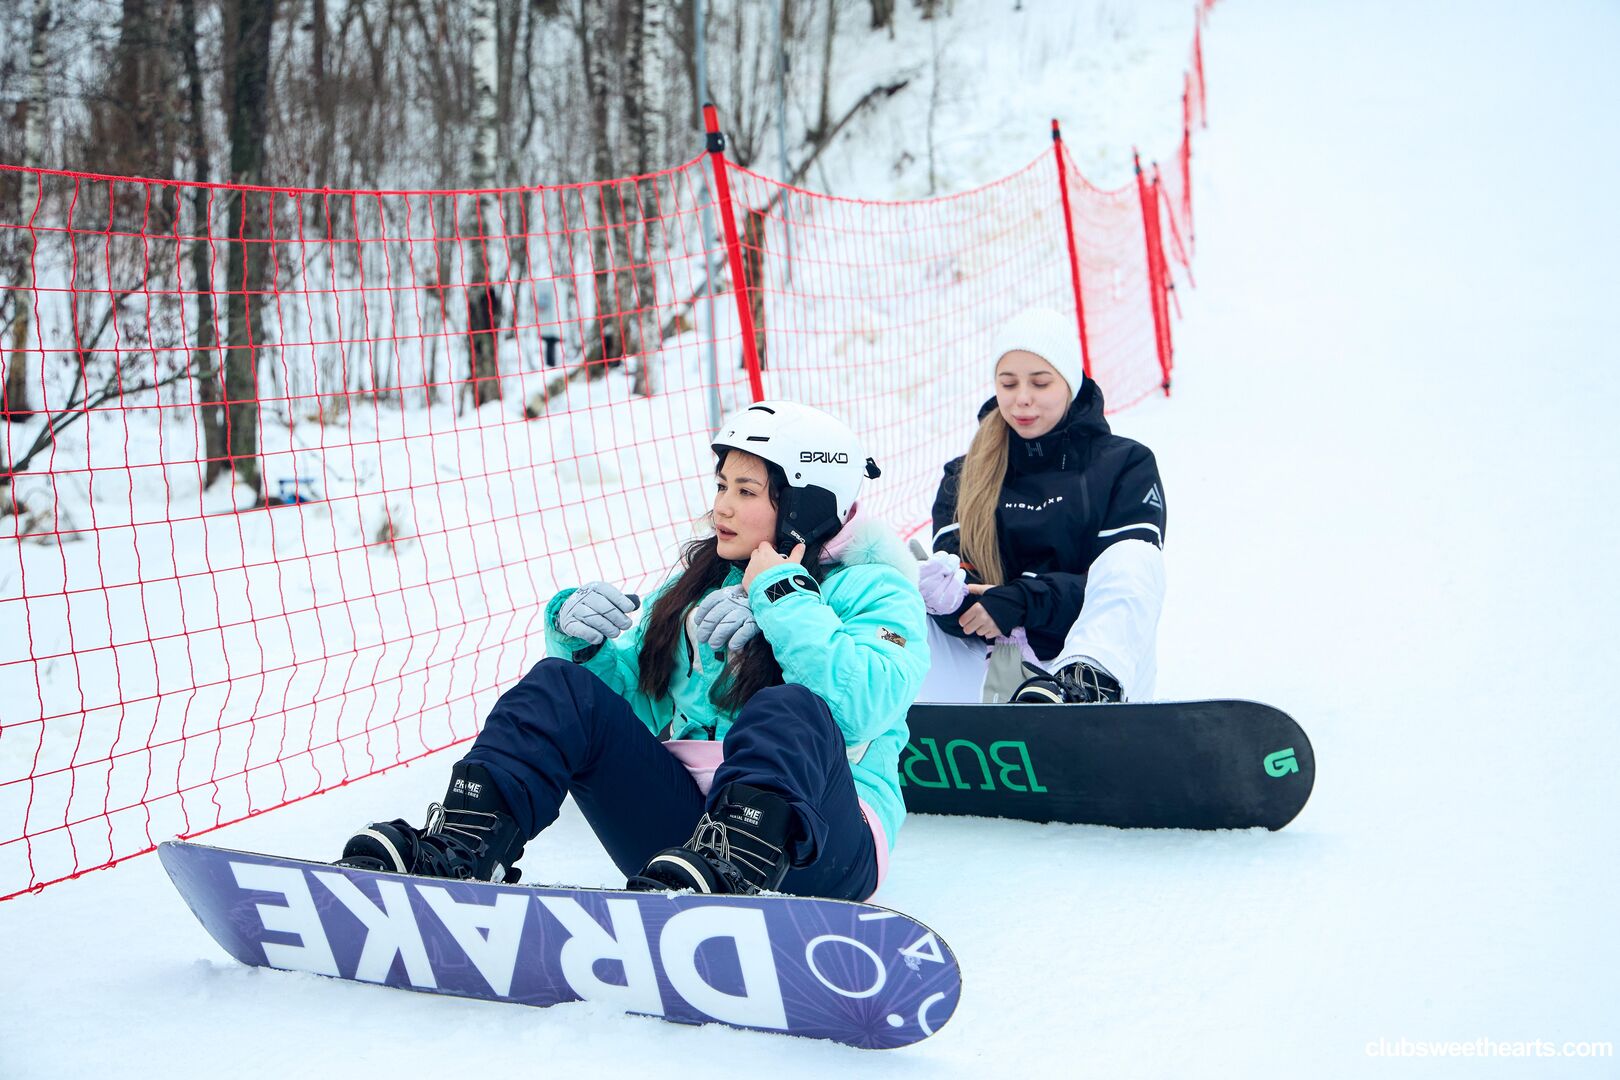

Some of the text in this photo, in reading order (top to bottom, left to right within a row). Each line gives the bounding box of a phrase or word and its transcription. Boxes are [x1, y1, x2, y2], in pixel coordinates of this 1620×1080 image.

[799, 451, 849, 464] BRIKO
[898, 737, 1048, 793] BUR
[454, 779, 481, 793] PRIME
[228, 861, 789, 1031] DRAKE
